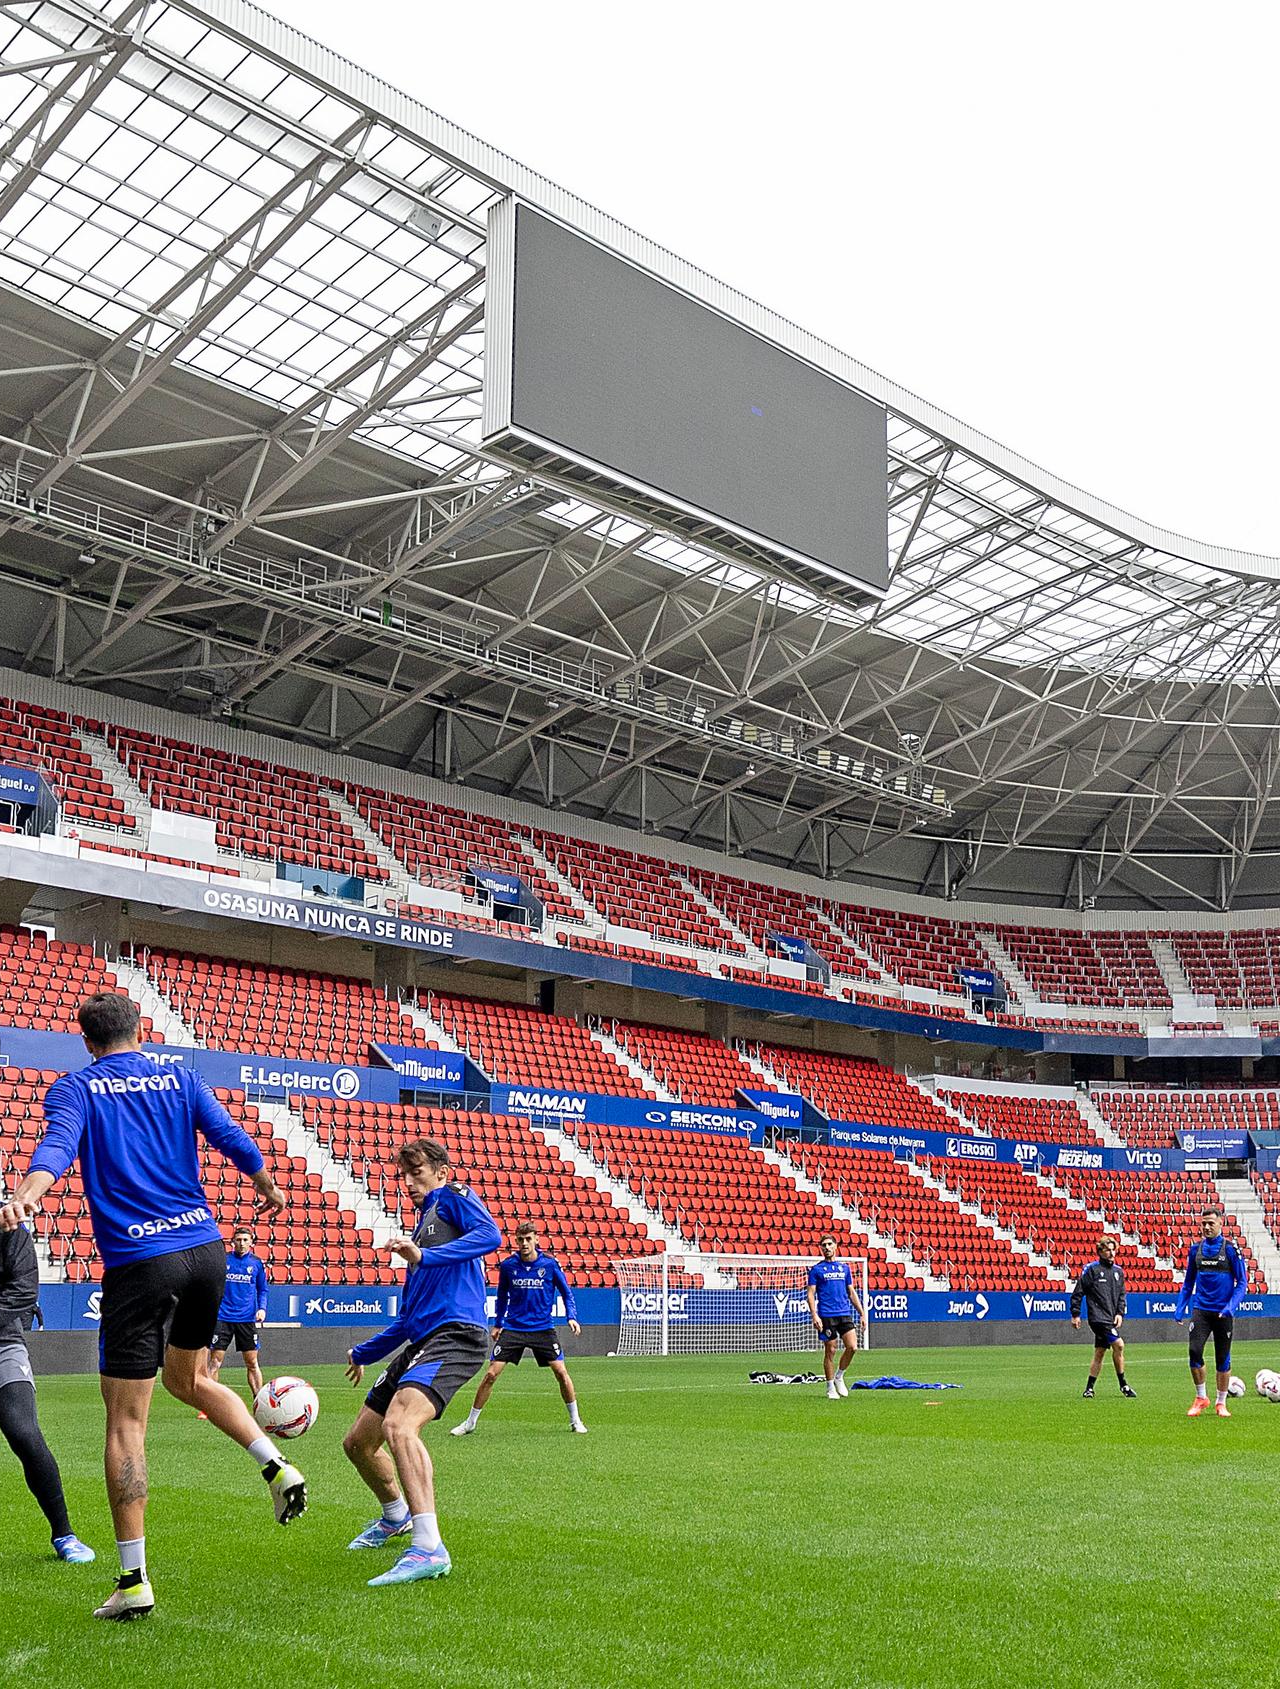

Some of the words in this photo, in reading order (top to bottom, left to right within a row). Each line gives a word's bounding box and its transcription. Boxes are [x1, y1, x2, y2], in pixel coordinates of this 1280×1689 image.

[203, 889, 300, 922] OSASUNA
[304, 907, 371, 935] NUNCA
[374, 920, 396, 939] SE
[400, 923, 454, 949] RINDE
[88, 1072, 181, 1095] macron
[239, 1065, 331, 1092] E.Leclerc
[507, 1091, 587, 1113] INAMAN
[670, 1110, 737, 1129] SERCOIN
[830, 1128, 861, 1142] Parques
[861, 1133, 888, 1145] Solares
[899, 1137, 926, 1149] Navarra
[961, 1140, 994, 1157] EROSKI
[1014, 1143, 1038, 1160] ATP
[1125, 1150, 1162, 1165] Virto
[323, 1298, 383, 1315] CaixaBank
[873, 1295, 908, 1311] CELER
[947, 1301, 974, 1316] Jaylo
[1032, 1300, 1066, 1312] macron
[1239, 1302, 1263, 1311] MOTOR
